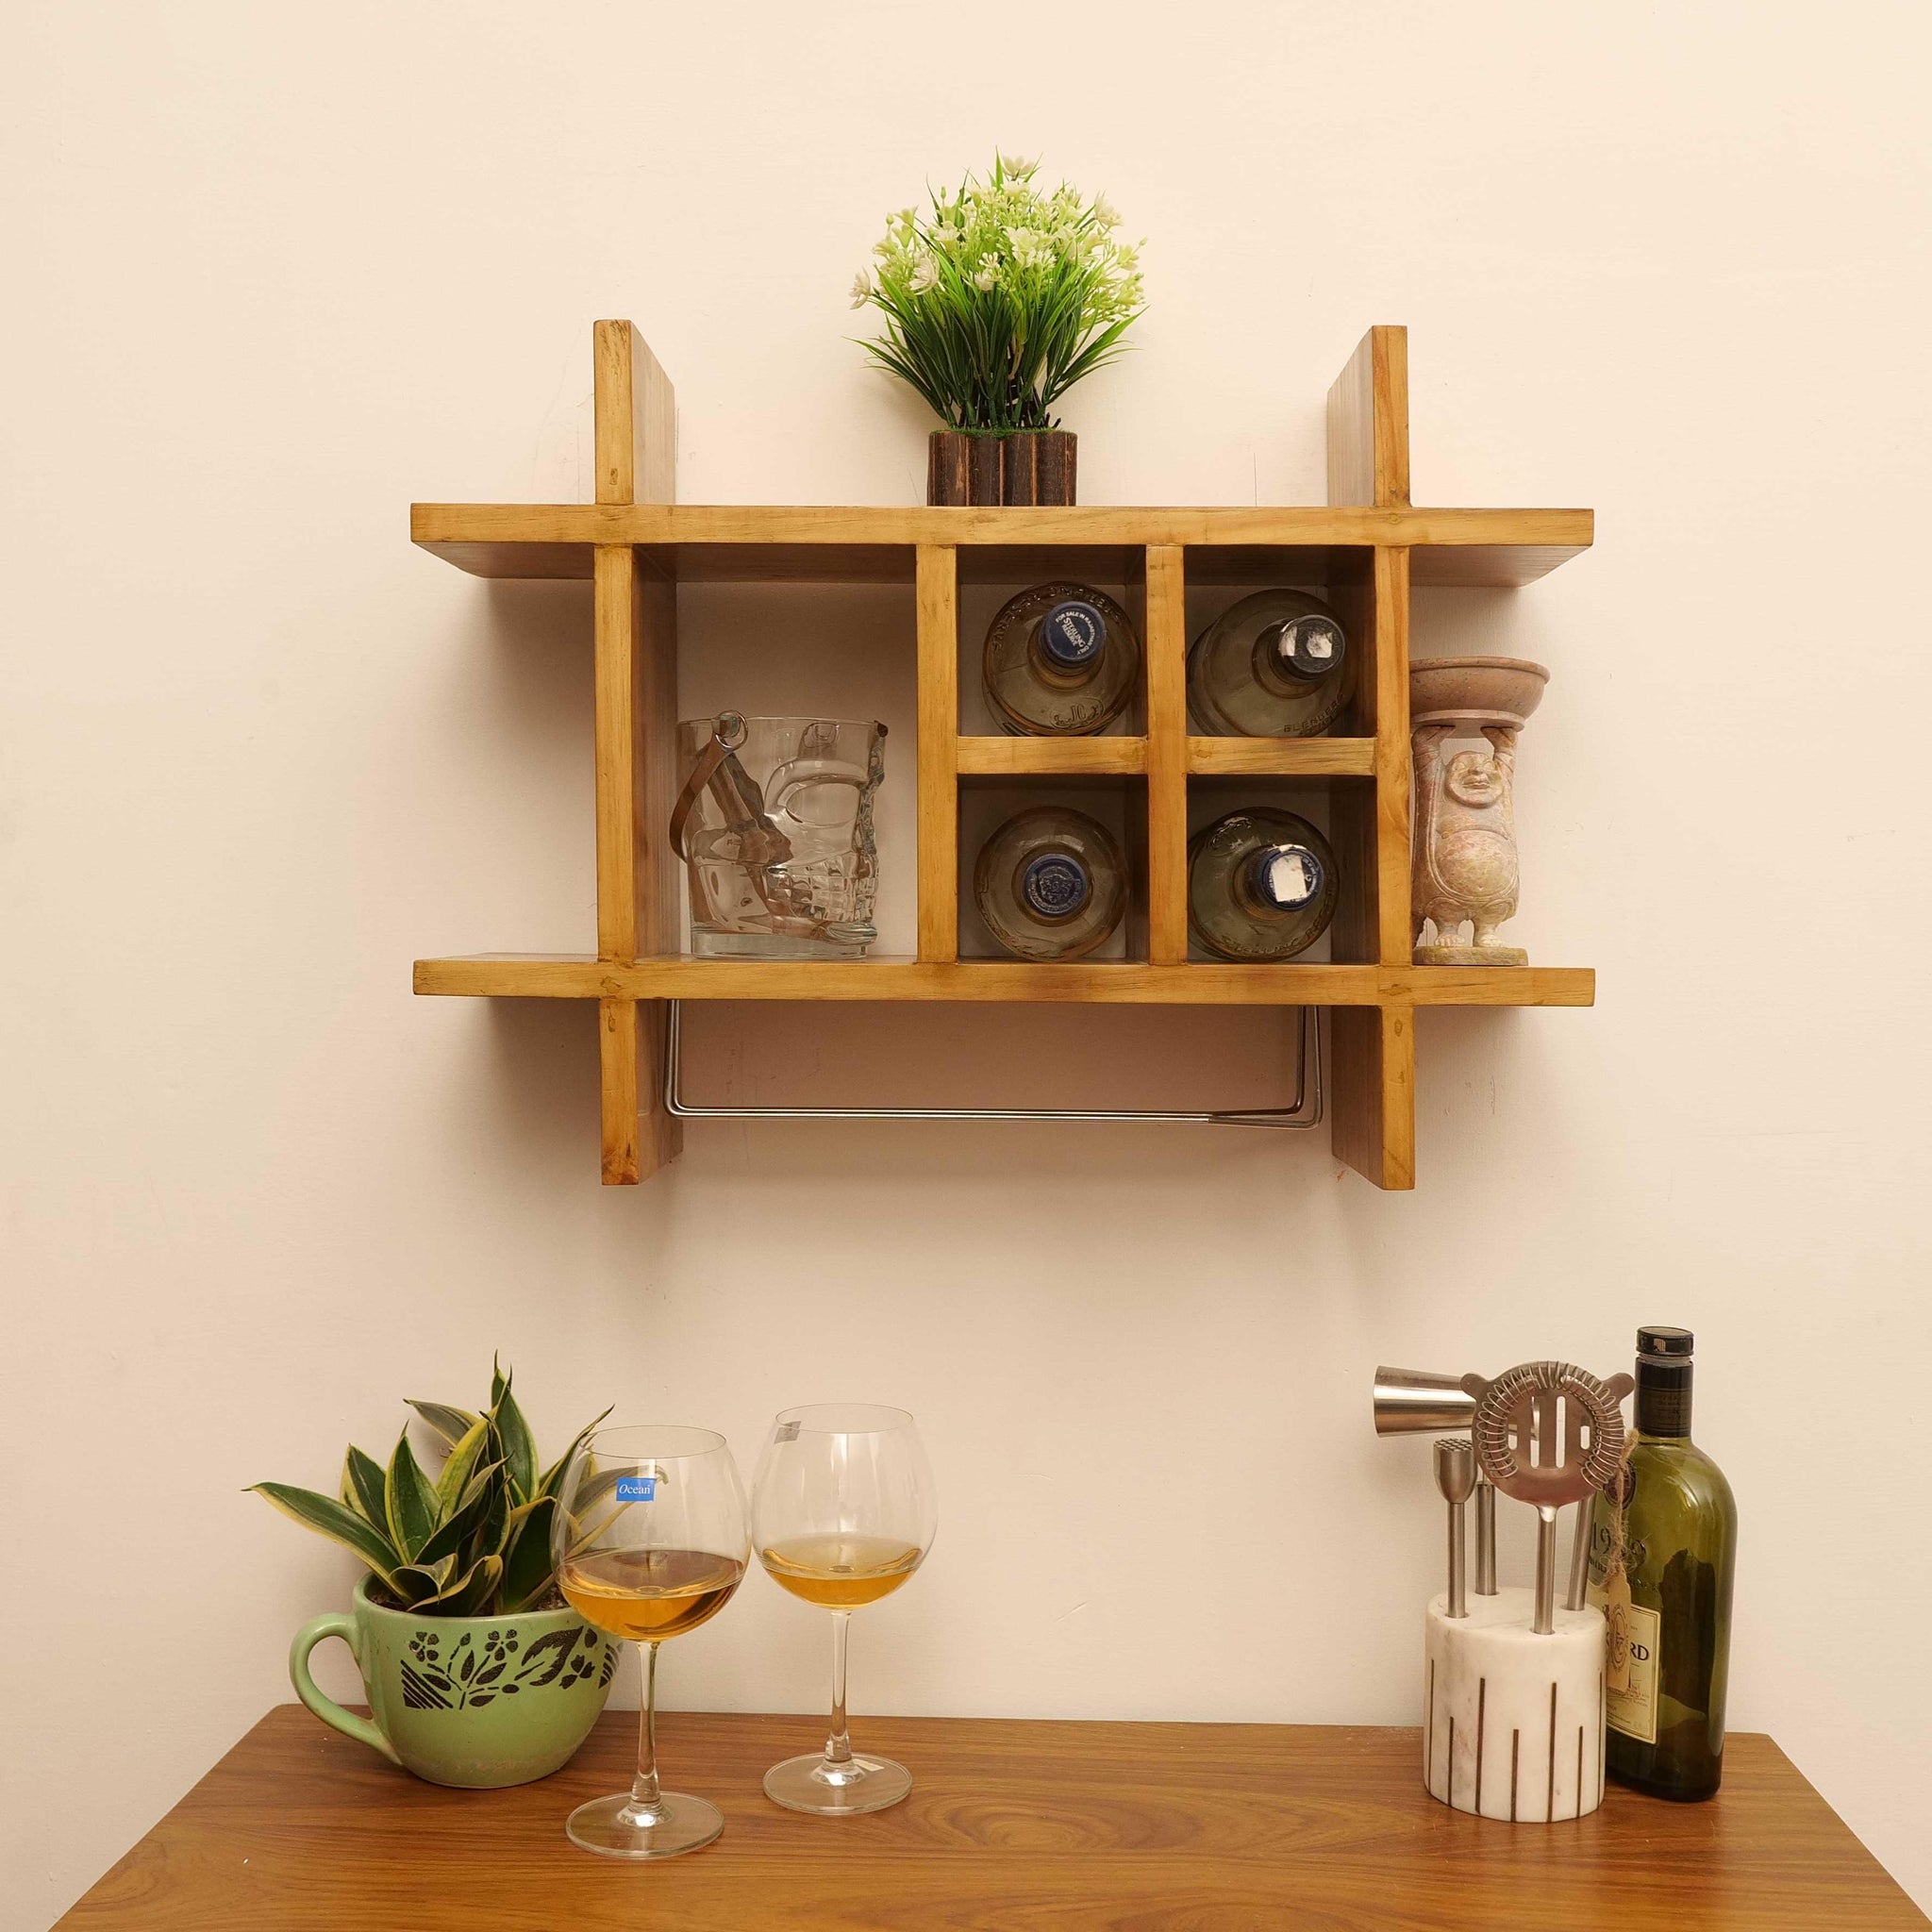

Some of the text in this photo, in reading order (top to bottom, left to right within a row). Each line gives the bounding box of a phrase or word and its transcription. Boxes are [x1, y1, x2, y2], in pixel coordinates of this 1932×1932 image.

[1061, 625, 1077, 646] RESERVE
[1063, 617, 1086, 647] STERLING
[1084, 617, 1095, 646] RAJASTHAN
[619, 1484, 651, 1494] Ocean
